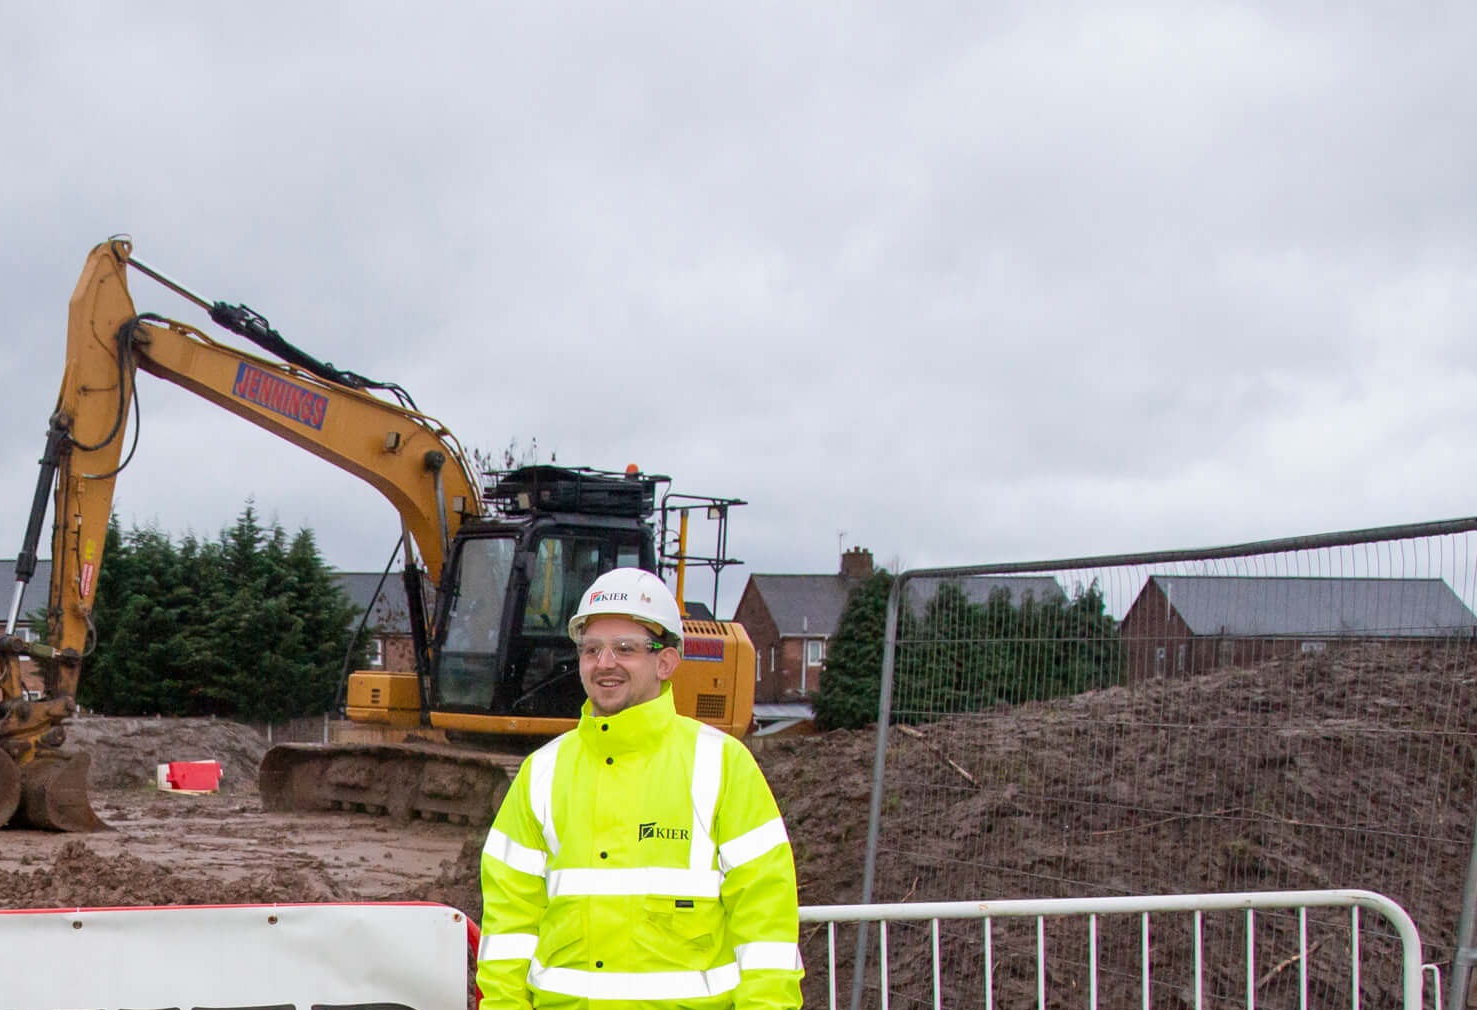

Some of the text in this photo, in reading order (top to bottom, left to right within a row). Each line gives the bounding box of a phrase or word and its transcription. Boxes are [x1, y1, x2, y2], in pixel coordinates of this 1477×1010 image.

[236, 366, 326, 426] JENNINGS
[602, 592, 629, 601] KIER
[656, 828, 690, 840] KIER
